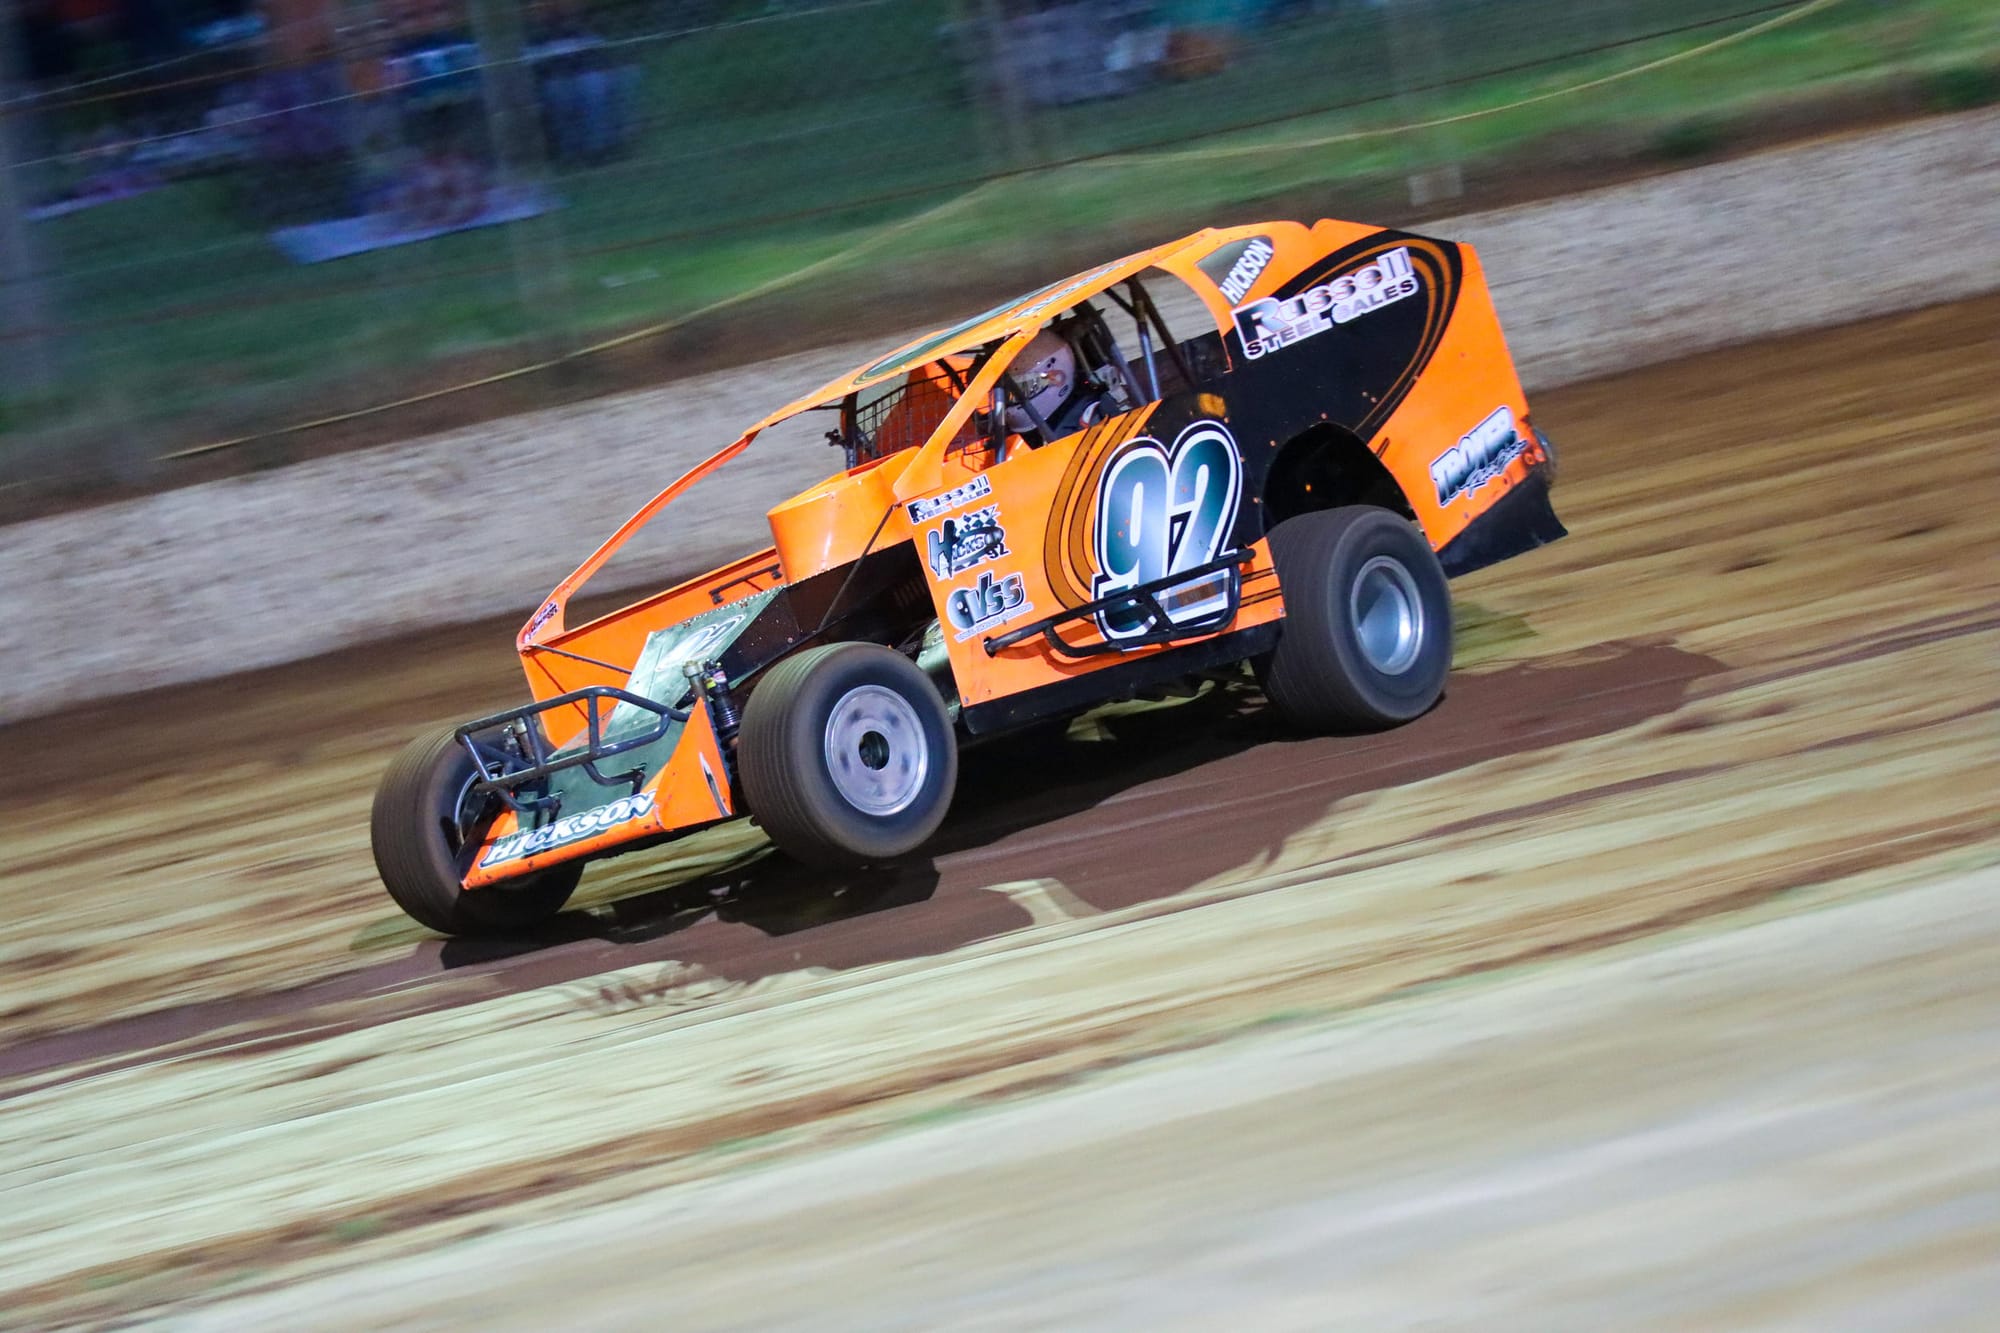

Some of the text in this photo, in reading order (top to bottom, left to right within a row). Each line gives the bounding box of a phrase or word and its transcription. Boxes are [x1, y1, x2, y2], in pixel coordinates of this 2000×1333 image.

[1219, 239, 1275, 305] HICKSON
[1232, 246, 1415, 343] Russell
[1246, 278, 1418, 358] STEEL SALES
[907, 474, 990, 519] Russell
[1093, 420, 1243, 650] 92
[479, 788, 658, 869] HICKSON
